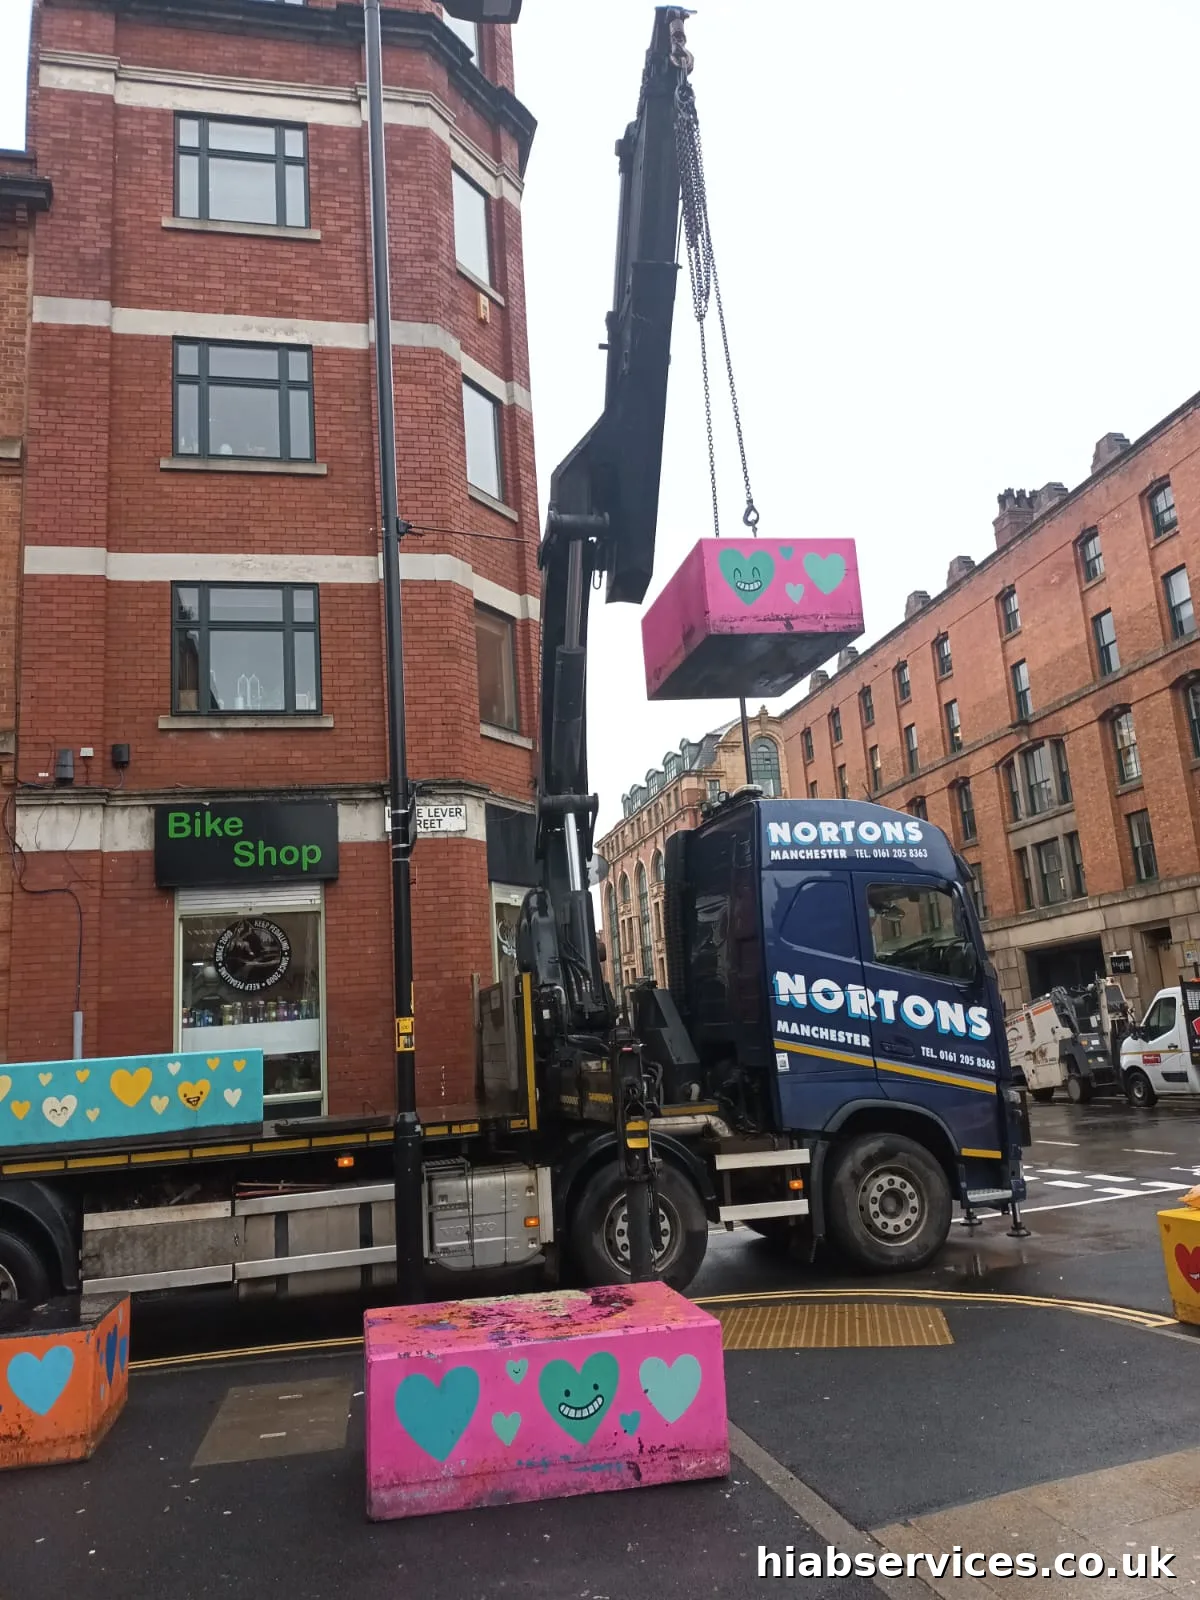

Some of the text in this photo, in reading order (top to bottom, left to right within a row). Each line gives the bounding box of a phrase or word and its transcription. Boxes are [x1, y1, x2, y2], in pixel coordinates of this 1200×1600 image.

[168, 811, 244, 838] Bike
[428, 807, 462, 818] LEVER
[767, 821, 924, 846] NORTONS
[233, 840, 322, 871] Shop
[770, 849, 928, 860] MANCHESTER TEL. 0161 205 8363
[215, 946, 225, 962] SINCE
[254, 920, 270, 929] KEEP
[279, 956, 290, 973] SINCE
[244, 983, 261, 991] KEEP
[773, 971, 991, 1041] NORTONS
[777, 1020, 871, 1048] MANCHESTER
[939, 1050, 957, 1063] 0161
[960, 1054, 975, 1066] 205
[977, 1058, 996, 1070] 8363
